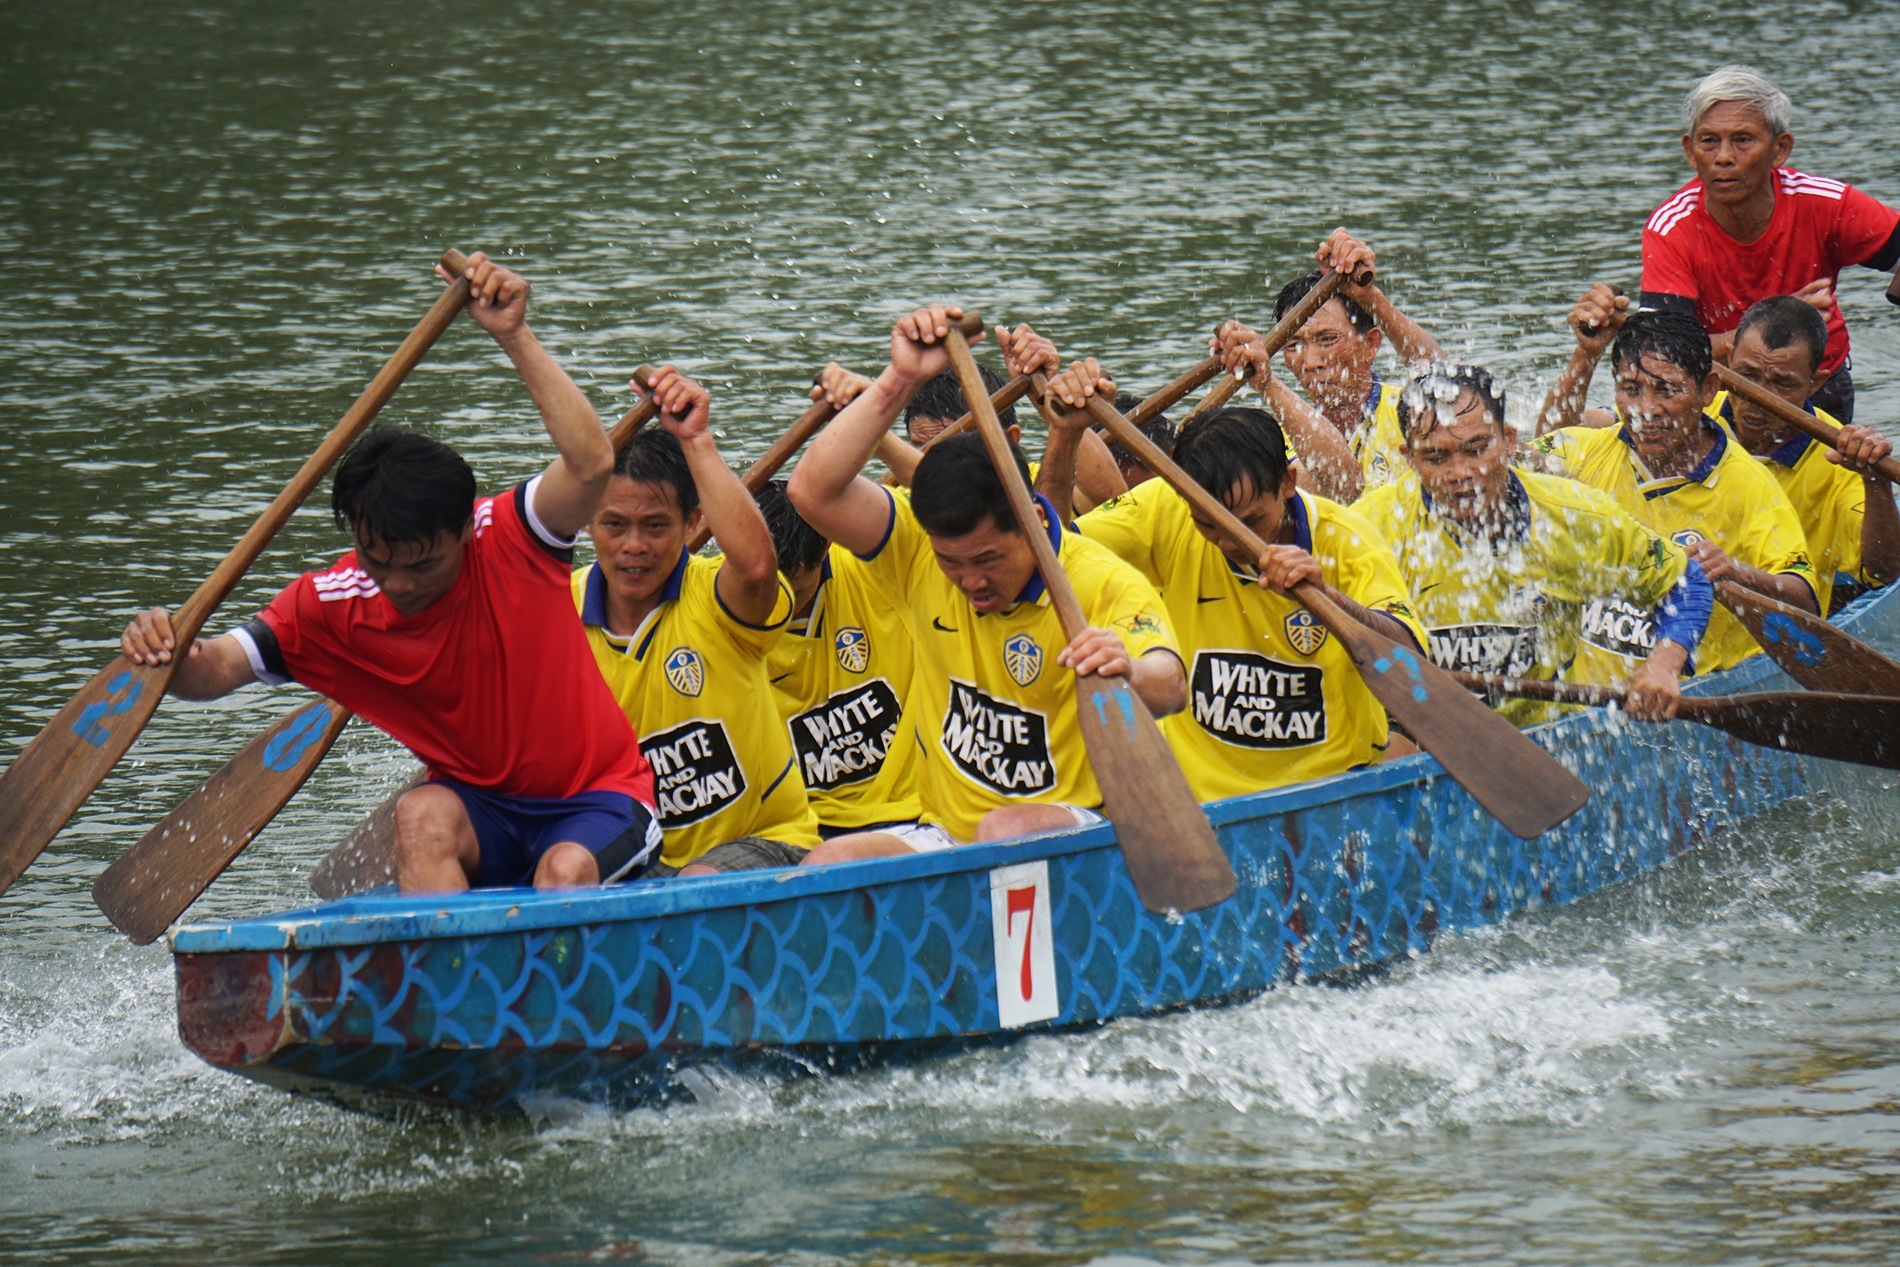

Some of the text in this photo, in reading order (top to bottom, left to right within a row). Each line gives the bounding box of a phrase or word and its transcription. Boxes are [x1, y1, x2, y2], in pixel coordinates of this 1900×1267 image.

[1580, 600, 1657, 648] MACK
[1210, 658, 1306, 698] WHYTE
[1195, 690, 1321, 739] MACKAY
[1233, 695, 1276, 710] AND
[643, 728, 713, 776] HYTE
[829, 731, 863, 754] AND
[945, 712, 1046, 789] MACKAY
[974, 730, 1004, 755] AD
[653, 766, 737, 820] ACKAY
[659, 767, 697, 791] AND
[1007, 885, 1036, 1002] 7
